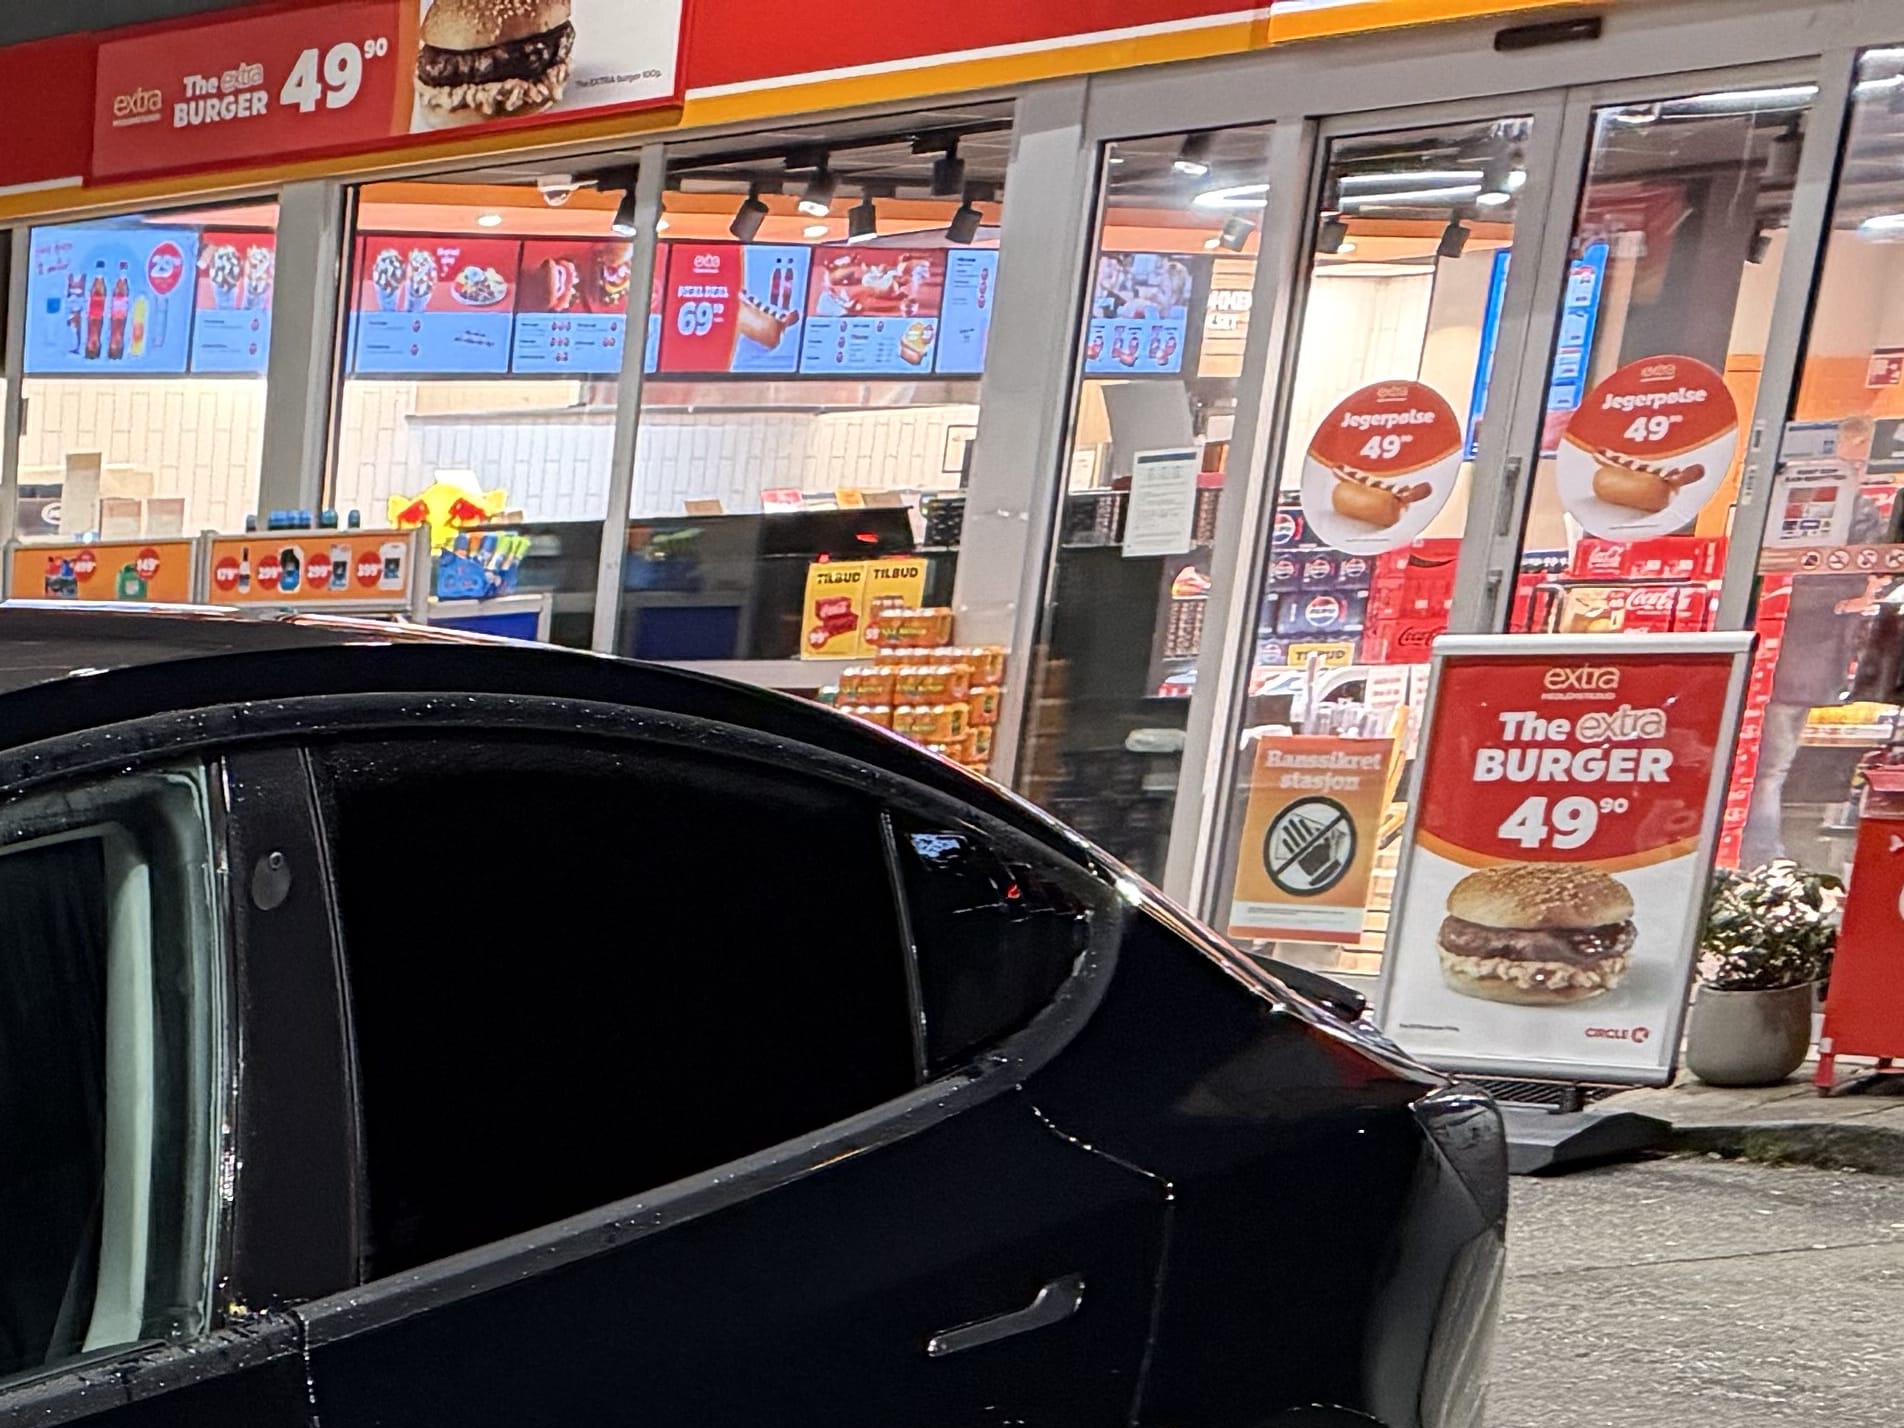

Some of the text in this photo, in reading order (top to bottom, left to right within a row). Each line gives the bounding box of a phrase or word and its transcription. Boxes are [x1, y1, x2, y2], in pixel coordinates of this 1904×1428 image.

[183, 62, 264, 98] The extra
[113, 87, 162, 117] extra
[173, 90, 269, 128] BURGER
[817, 571, 861, 584] TILBUD
[873, 567, 918, 580] TILBUD
[1544, 663, 1620, 690] extra
[1499, 704, 1667, 743] The extra
[1473, 748, 1673, 782] BURGER
[1280, 772, 1361, 793] stasjon
